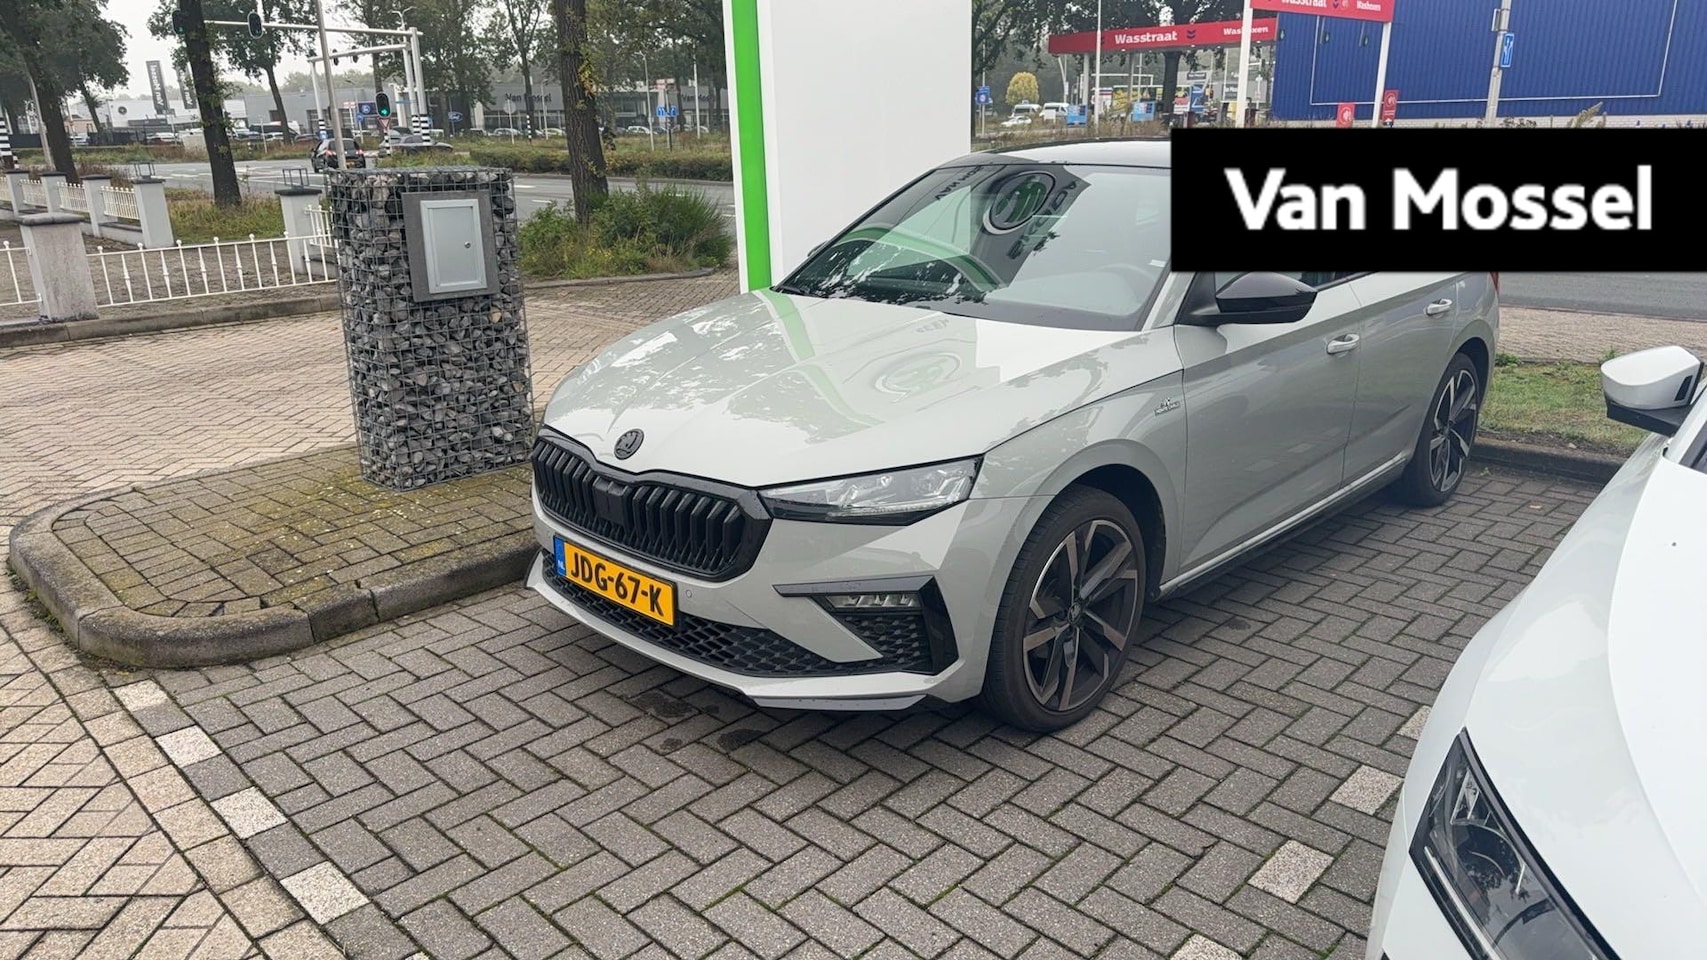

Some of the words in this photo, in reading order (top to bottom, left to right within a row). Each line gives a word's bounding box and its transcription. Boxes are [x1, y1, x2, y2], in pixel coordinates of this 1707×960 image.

[1114, 31, 1178, 44] Wasstraat
[1223, 27, 1269, 36] Wasxen
[557, 560, 565, 571] NL
[570, 552, 664, 617] JDG-67-K
